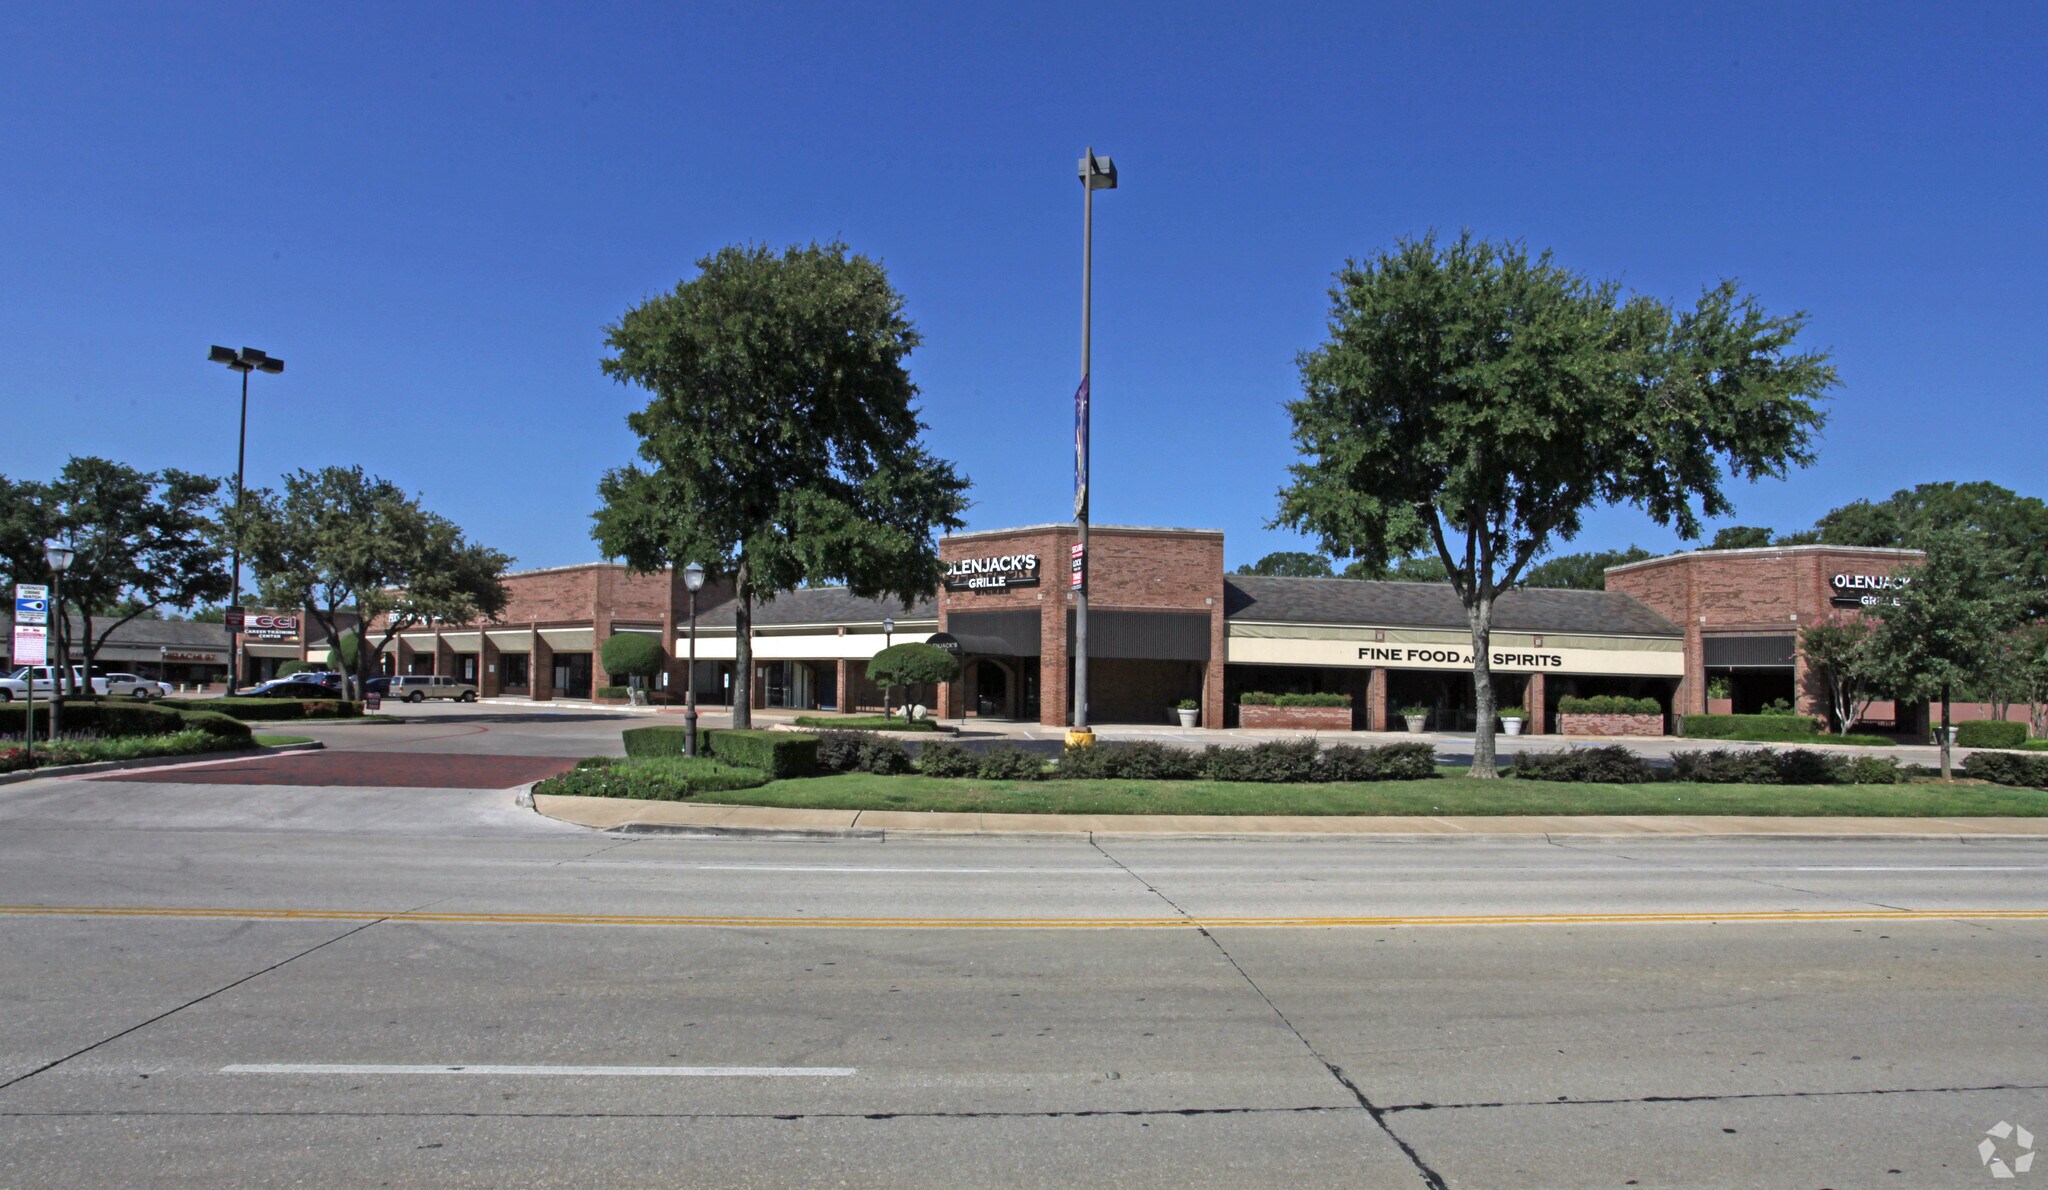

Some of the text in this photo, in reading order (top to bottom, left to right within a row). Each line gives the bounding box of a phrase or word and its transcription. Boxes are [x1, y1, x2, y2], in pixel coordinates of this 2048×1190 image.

[968, 576, 1006, 589] GRILLE
[255, 615, 296, 628] CCI
[1358, 647, 1562, 667] FINE FOOD AN SPIRITS
